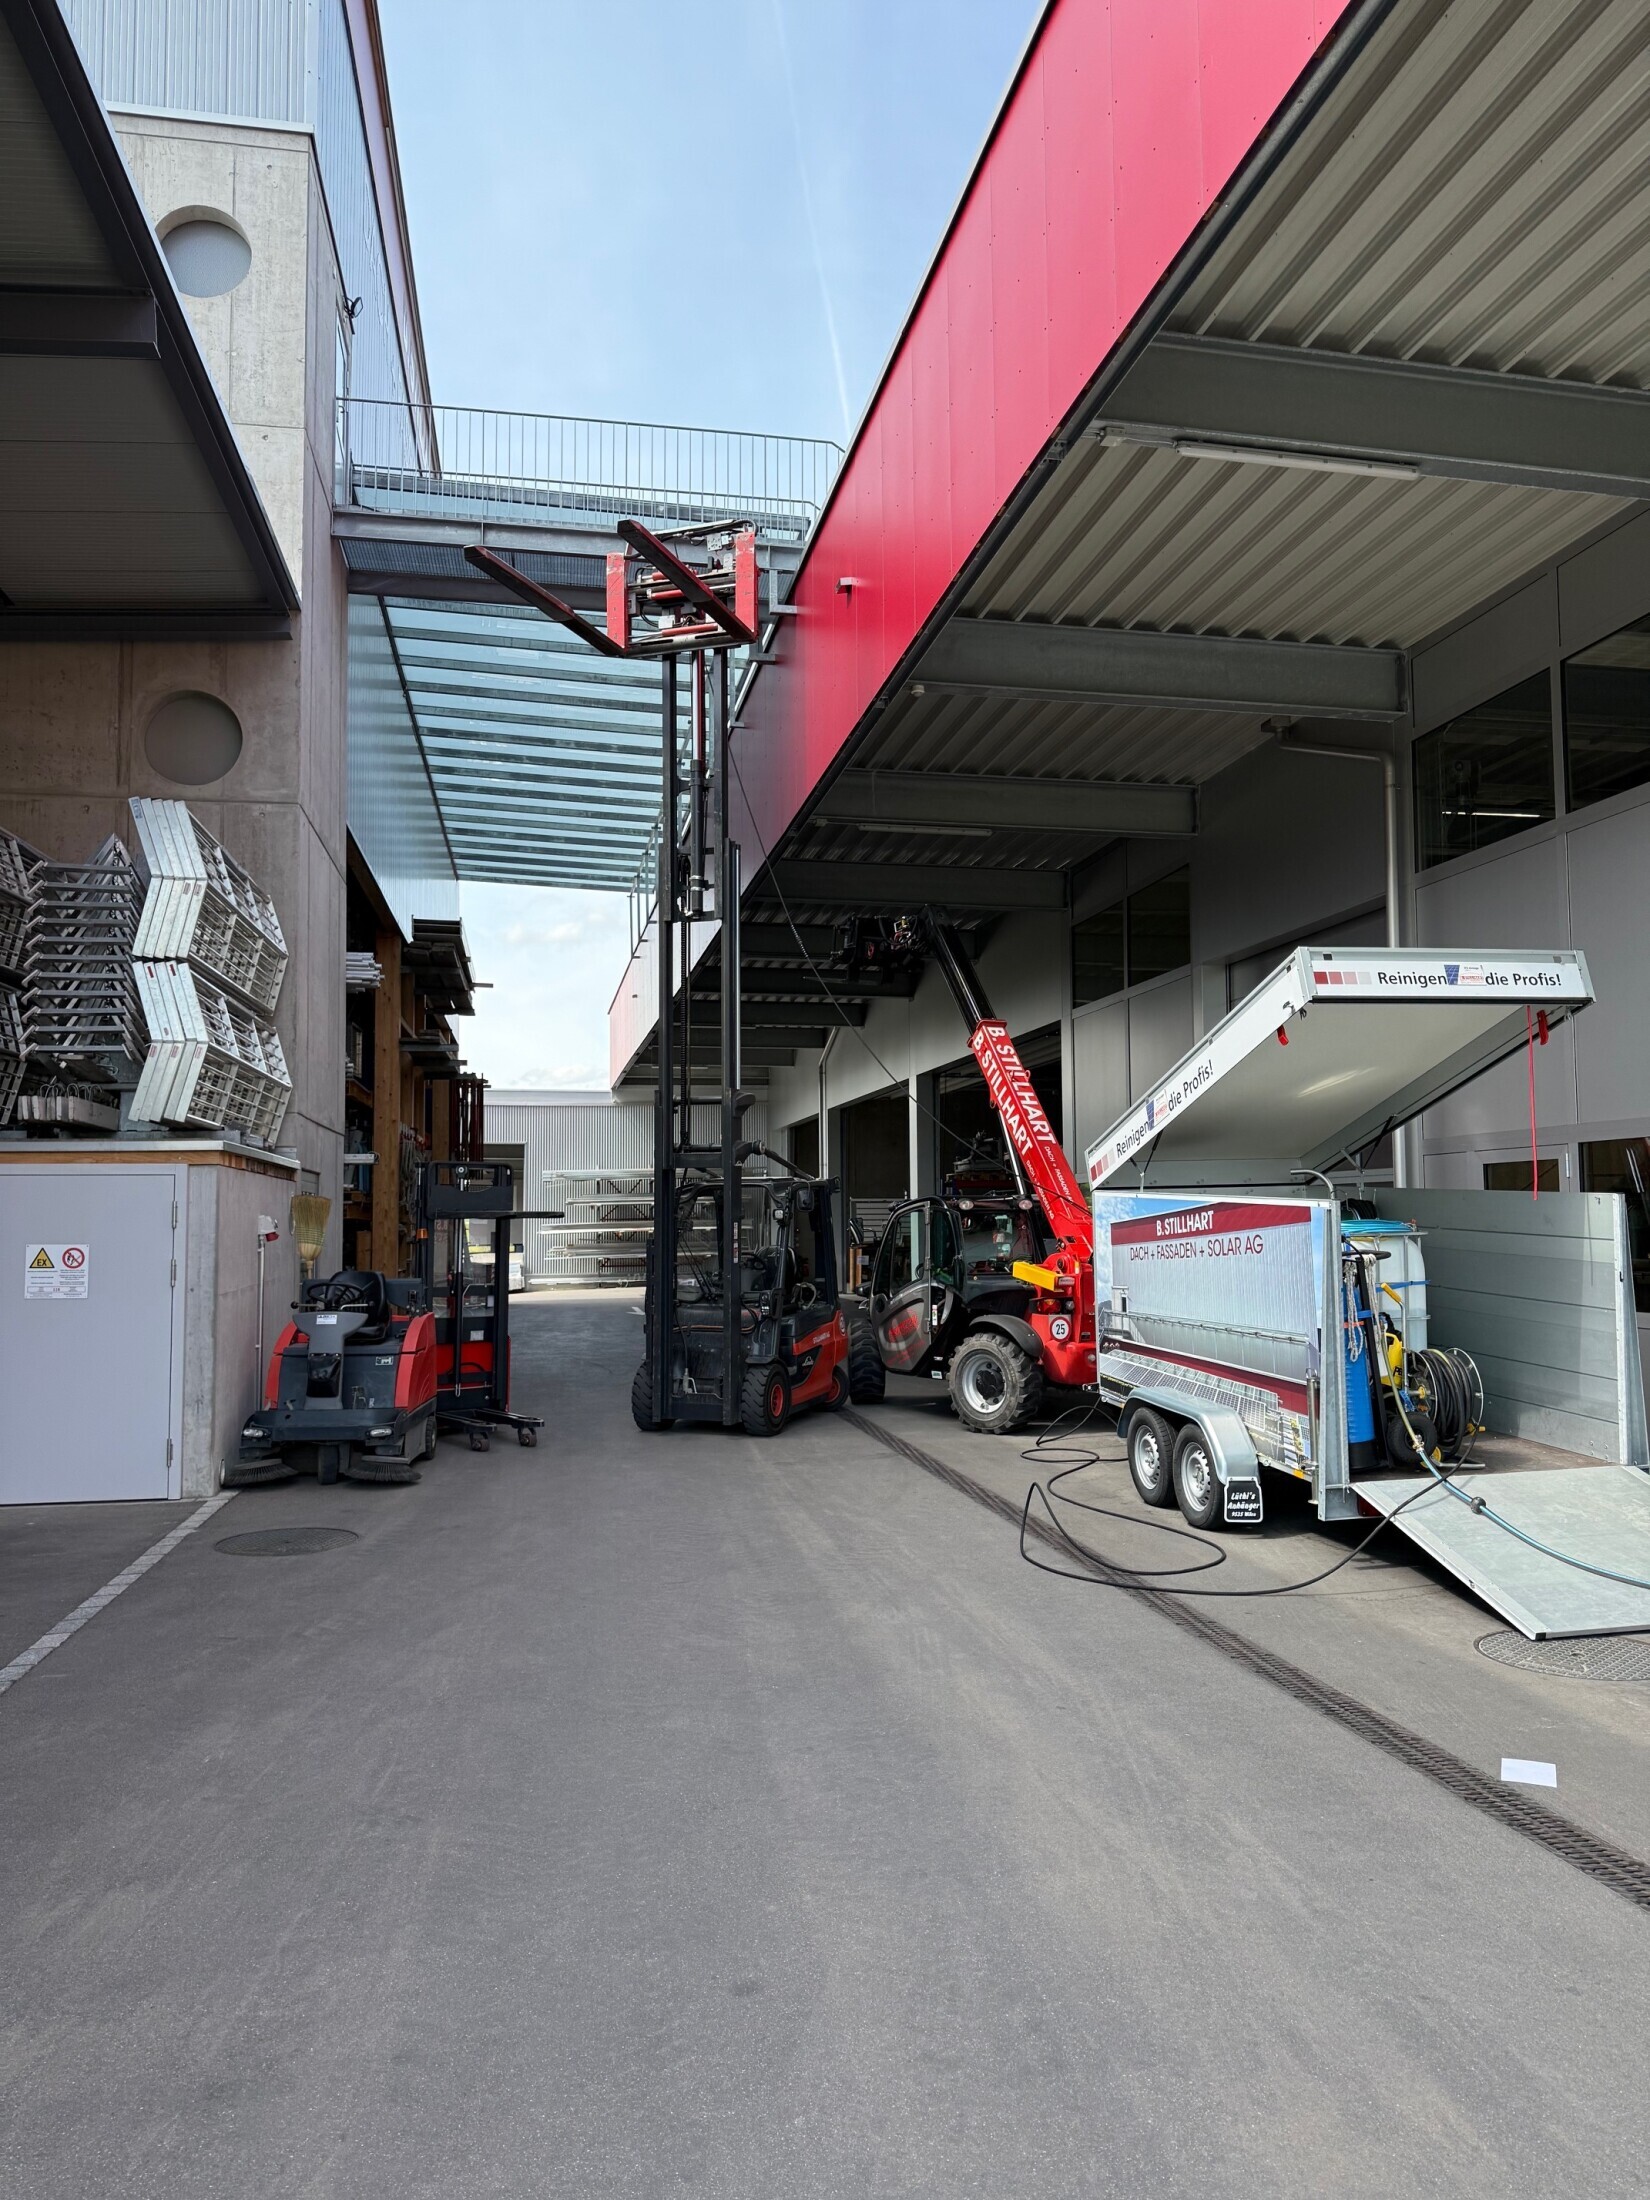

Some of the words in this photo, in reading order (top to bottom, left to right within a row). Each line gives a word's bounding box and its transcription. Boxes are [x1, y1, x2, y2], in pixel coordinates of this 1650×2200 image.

[1377, 971, 1448, 988] Reinigen
[1485, 972, 1509, 986] die
[1512, 972, 1562, 986] Profis!
[987, 1026, 1006, 1042] B.
[973, 1030, 984, 1056] B.
[982, 1049, 1033, 1156] STILLHART
[996, 1044, 1056, 1144] STILLHART
[1116, 1121, 1150, 1158] Reinigen
[1168, 1091, 1182, 1112] die
[1183, 1059, 1214, 1098] Profis!
[1044, 1146, 1056, 1162] DACH
[1130, 1246, 1149, 1261] DACH
[1156, 1242, 1197, 1260] FASSADEN
[1207, 1236, 1242, 1257] SOLAR
[1244, 1234, 1264, 1255] AG
[37, 1259, 47, 1267] EX
[1055, 1323, 1066, 1335] 25
[1227, 1501, 1260, 1511] Anhänger
